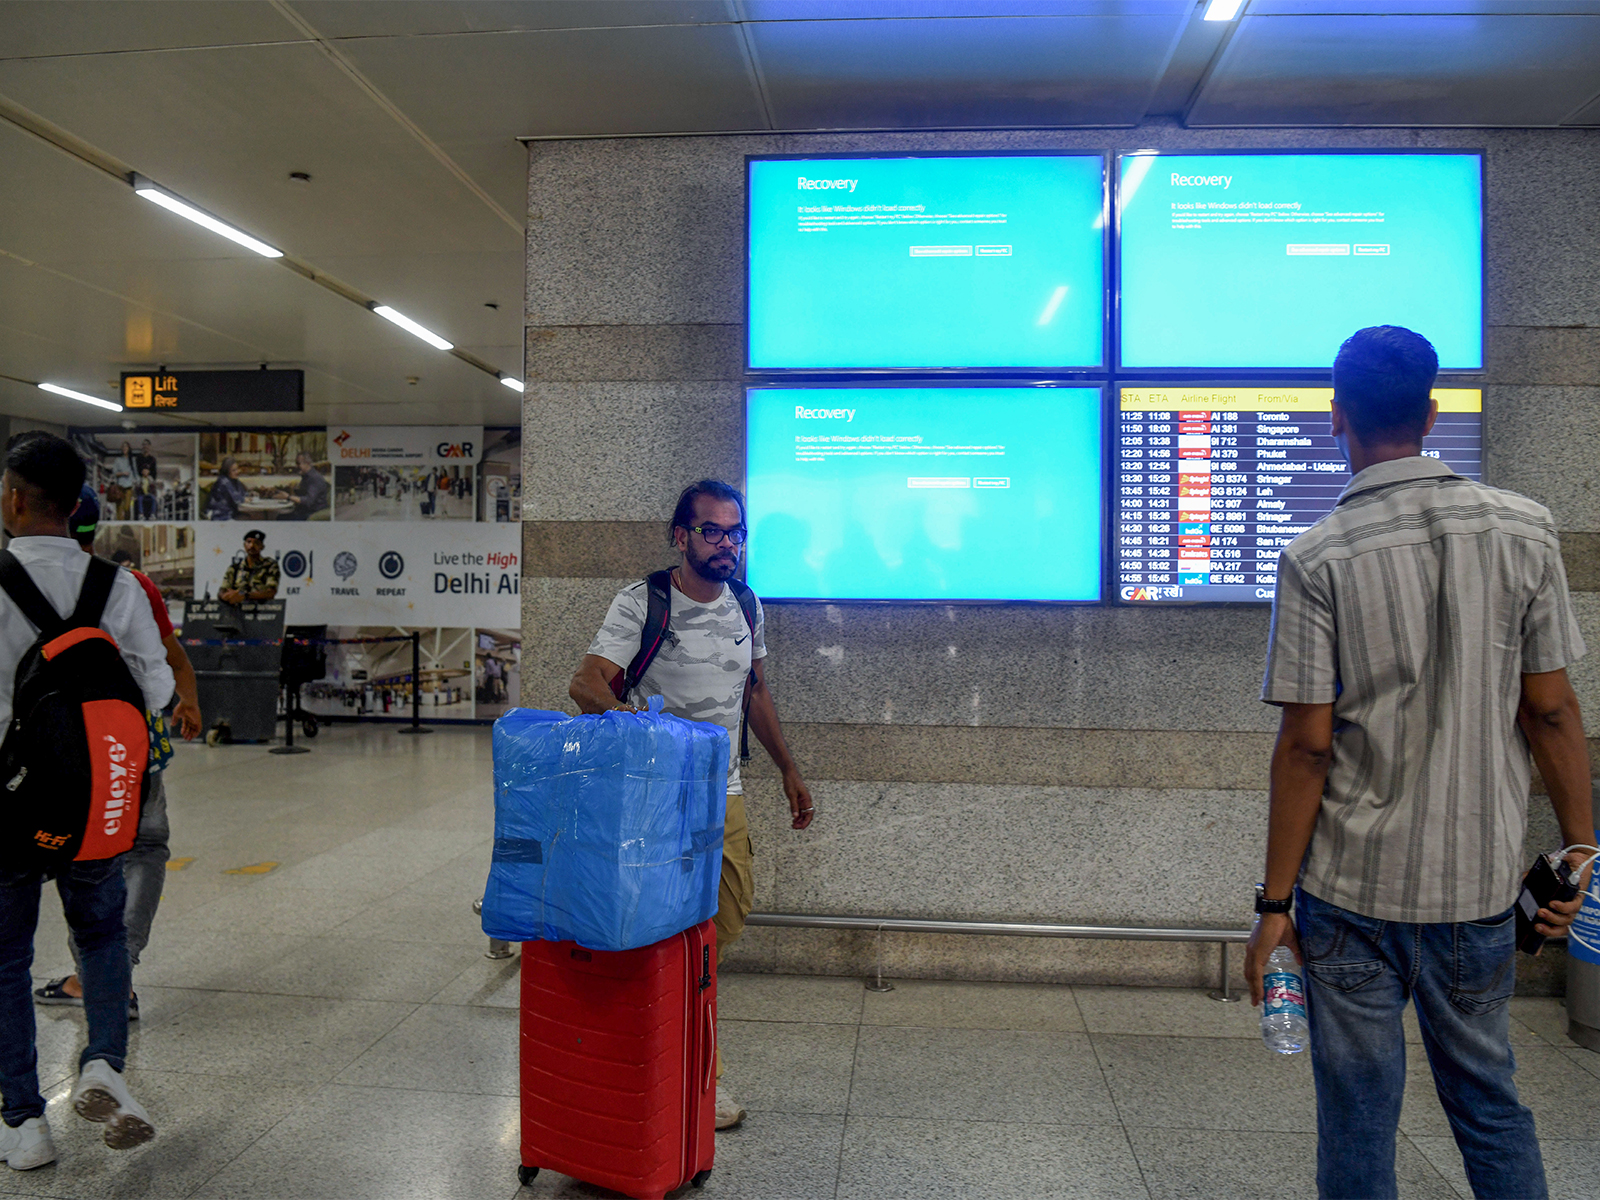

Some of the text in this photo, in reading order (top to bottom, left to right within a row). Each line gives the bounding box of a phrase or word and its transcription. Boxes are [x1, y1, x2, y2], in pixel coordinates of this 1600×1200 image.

[798, 177, 858, 192] Recovery
[1171, 173, 1232, 189] Recovery
[1273, 202, 1301, 211] correctly
[155, 376, 178, 391] Lift
[1181, 394, 1209, 402] Airline
[1212, 394, 1237, 405] Flight
[1257, 395, 1299, 403] From/Via
[795, 406, 856, 422] Recovery
[341, 447, 370, 458] DELHI
[437, 442, 474, 458] GMR
[434, 552, 517, 569] Live the High
[434, 573, 518, 594] Delhi Ai
[286, 587, 300, 595] EAT
[331, 587, 359, 596] TRAVEL
[376, 588, 406, 596] REPEAT
[1120, 587, 1159, 600] GMR
